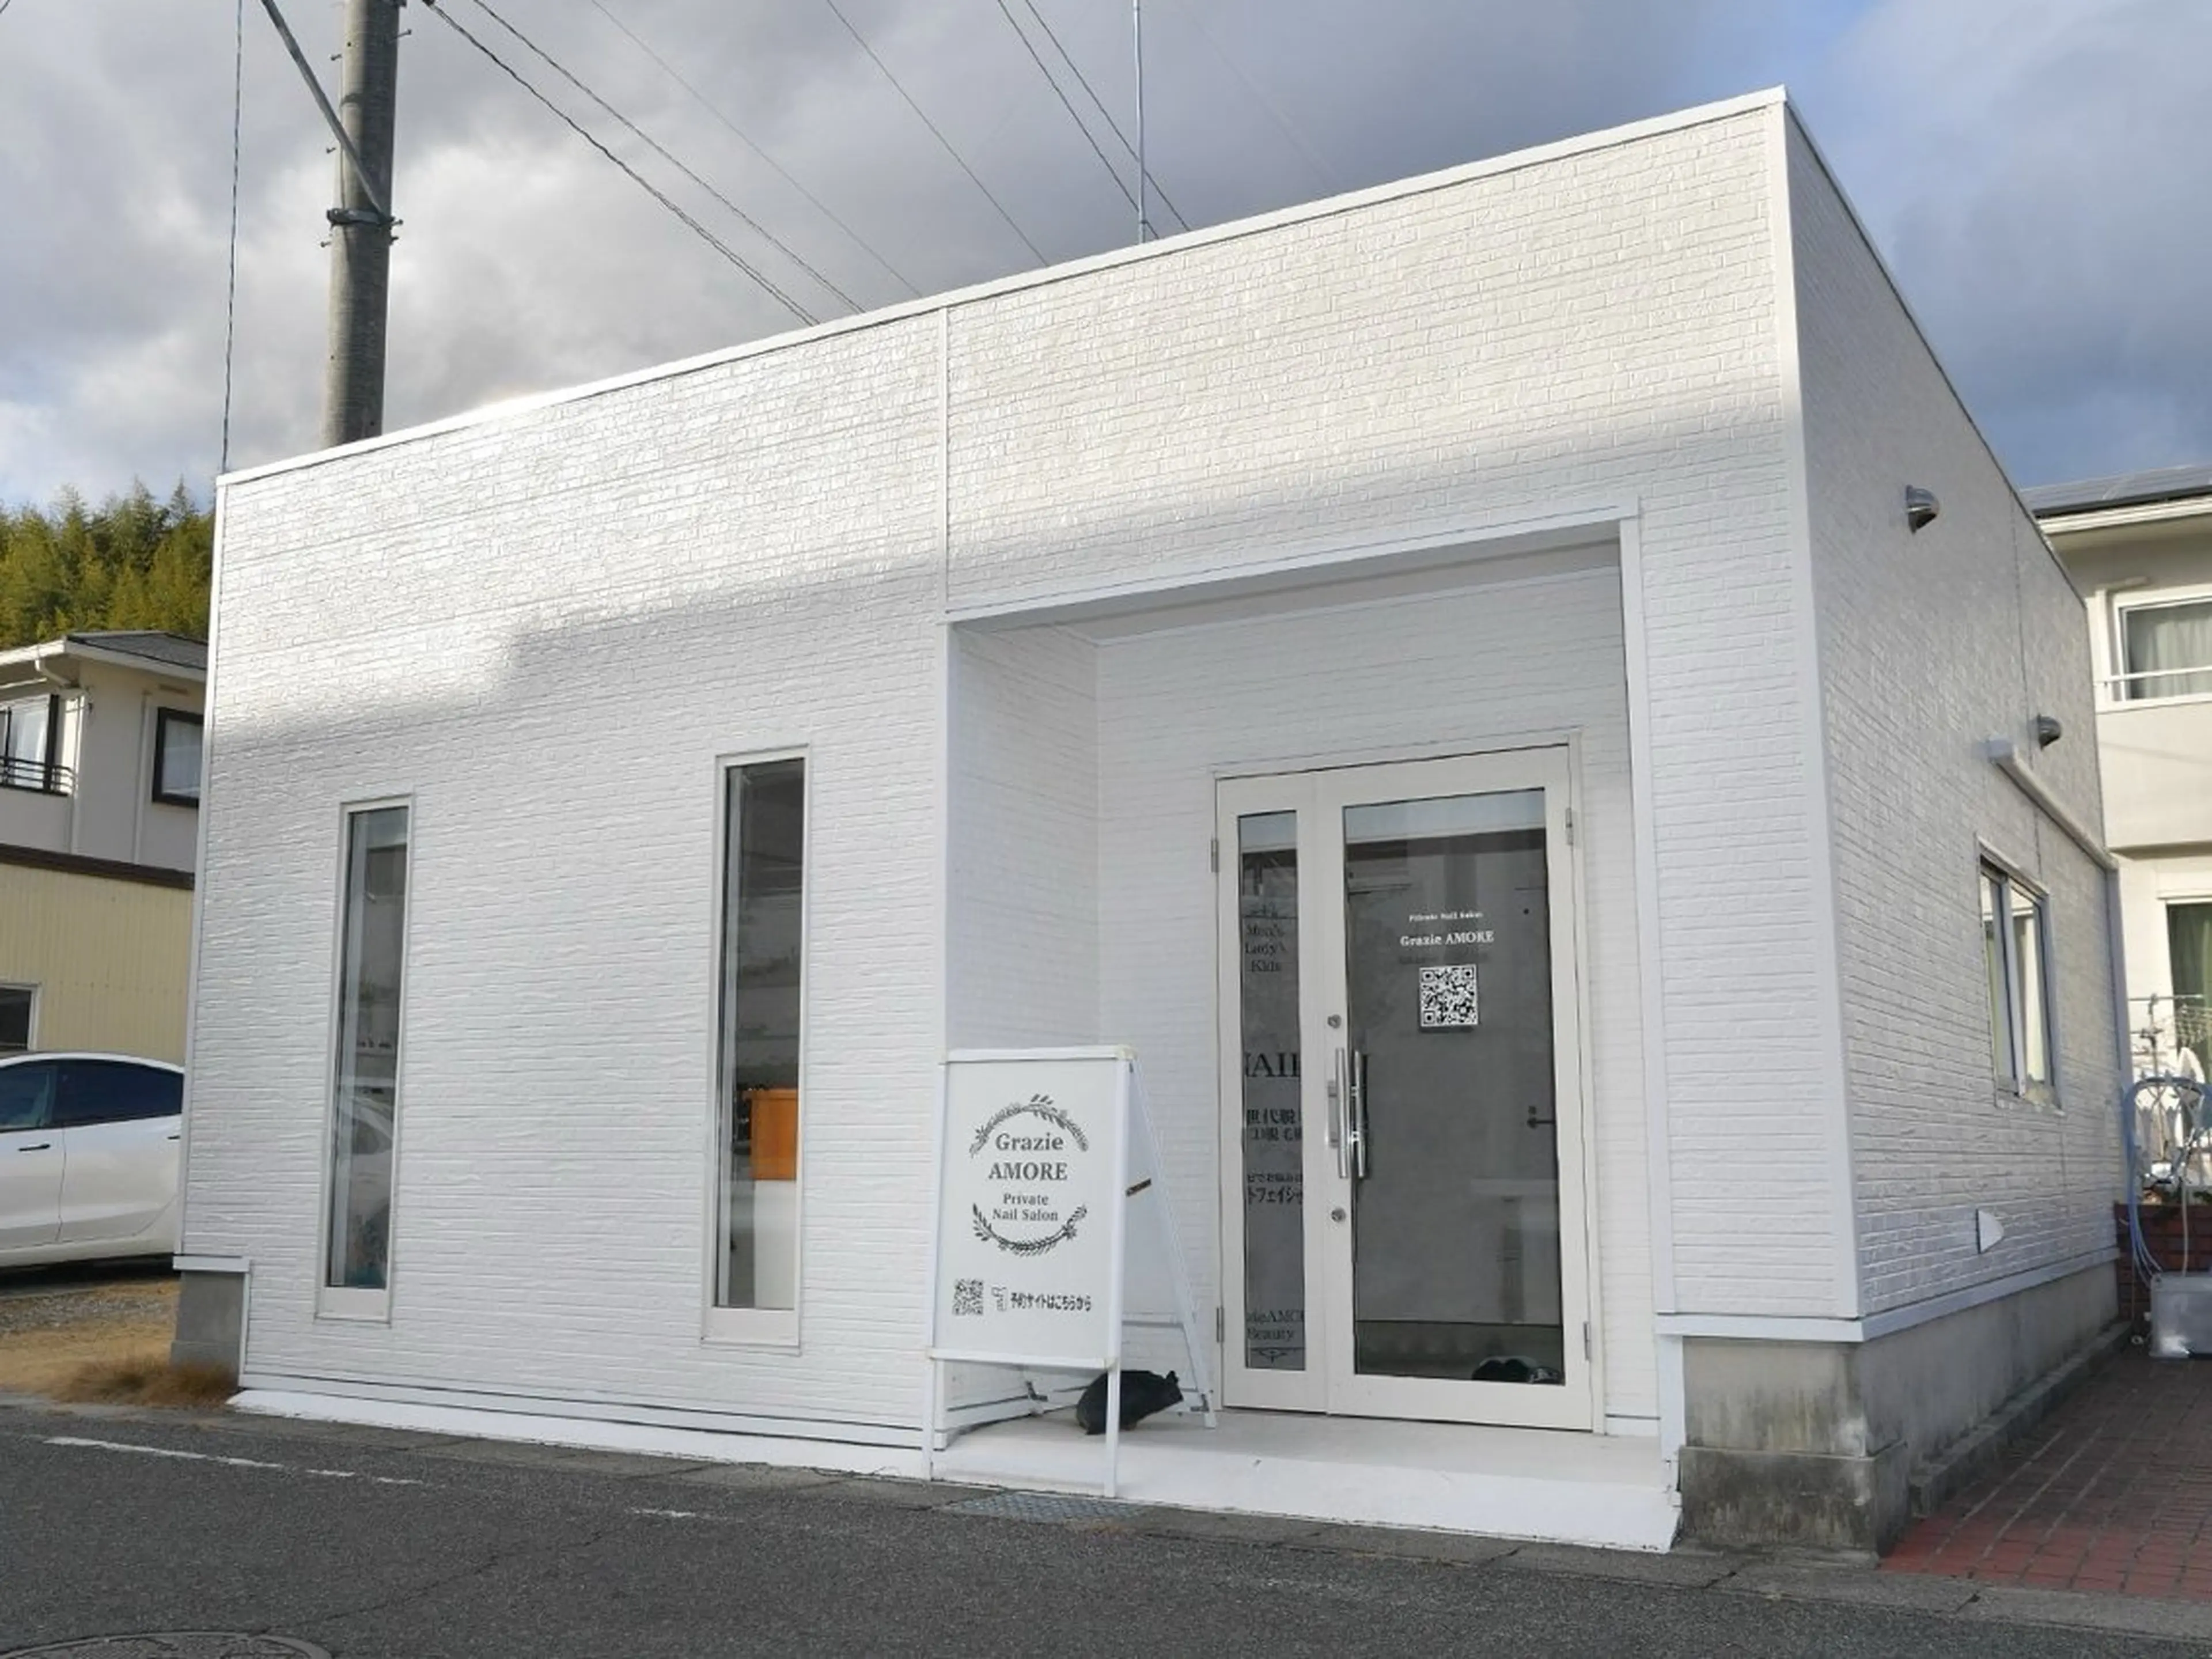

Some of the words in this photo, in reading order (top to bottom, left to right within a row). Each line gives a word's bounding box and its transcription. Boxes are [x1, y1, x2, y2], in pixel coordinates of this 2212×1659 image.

[1400, 933, 1442, 946] Grazie
[1445, 930, 1495, 945] AMORE
[995, 1131, 1064, 1152] Grazie
[988, 1161, 1069, 1181] AMORE
[1003, 1192, 1049, 1207] Private
[993, 1207, 1018, 1221] Nail
[1021, 1208, 1059, 1222] Salon
